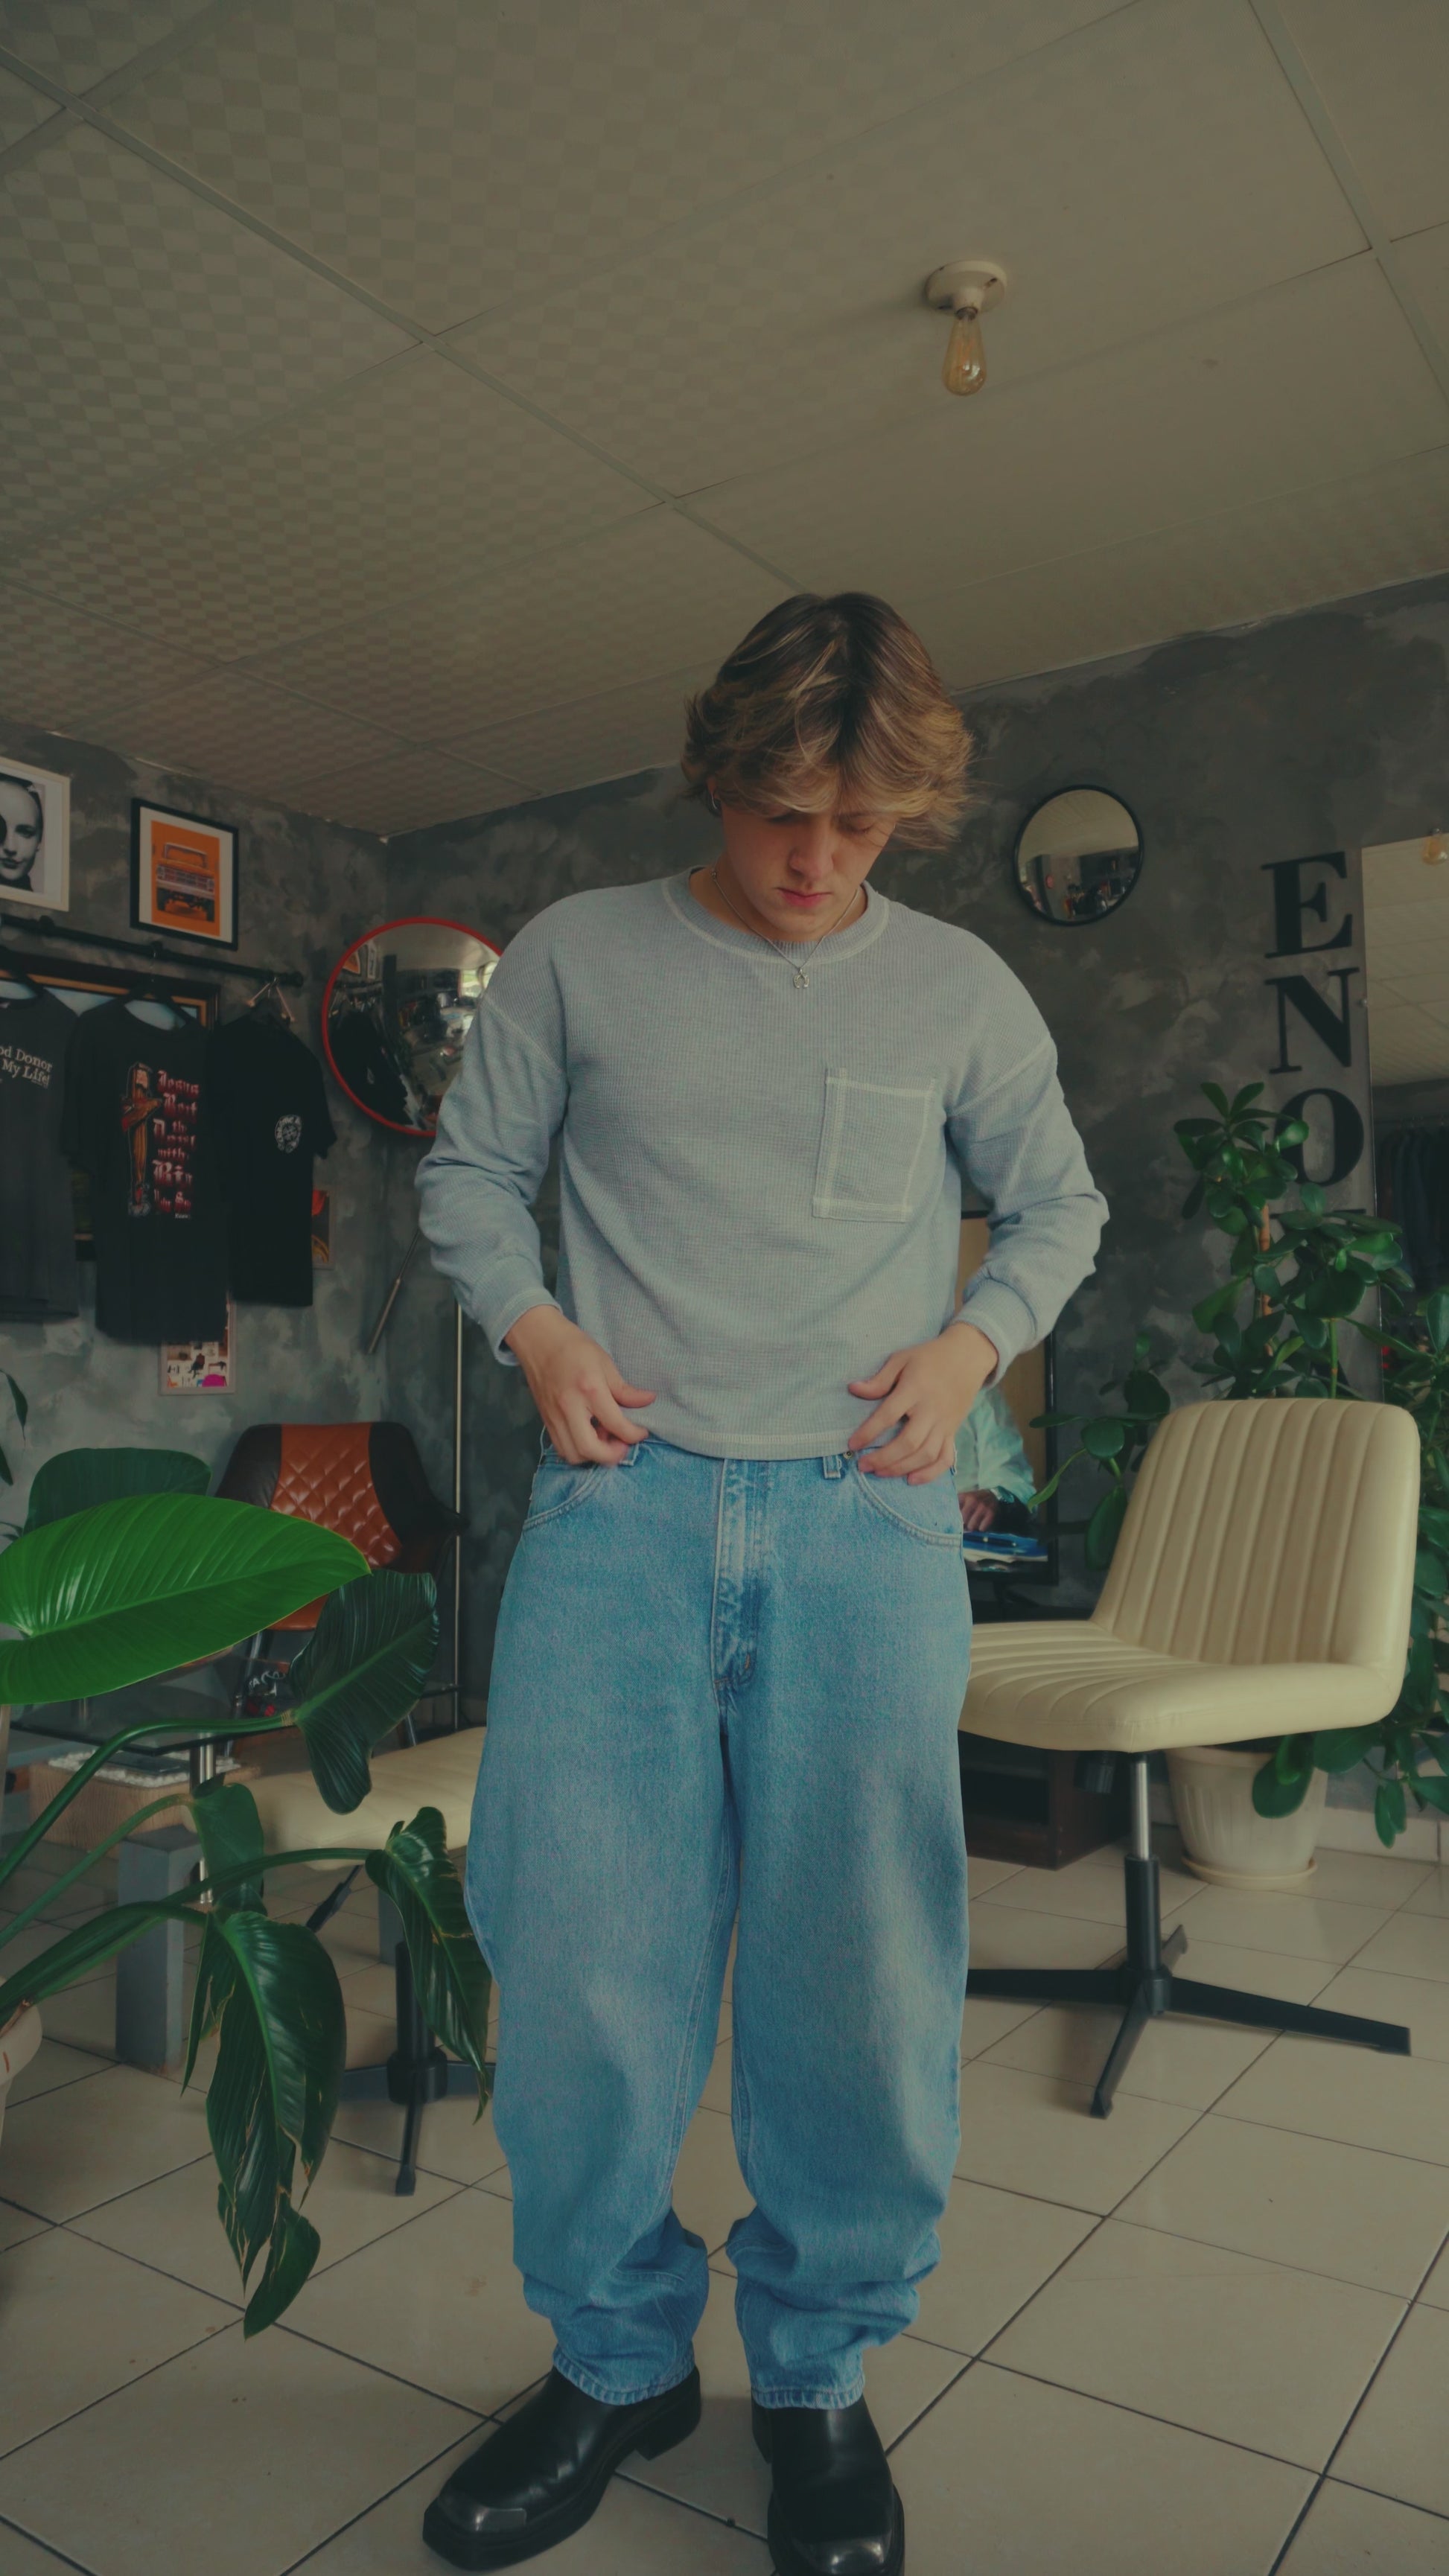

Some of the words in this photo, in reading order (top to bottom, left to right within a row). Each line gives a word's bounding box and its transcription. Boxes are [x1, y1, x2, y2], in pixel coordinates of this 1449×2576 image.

[1, 1058, 20, 1078] My
[15, 1048, 52, 1072] Donor
[1260, 850, 1367, 1386] ENO
